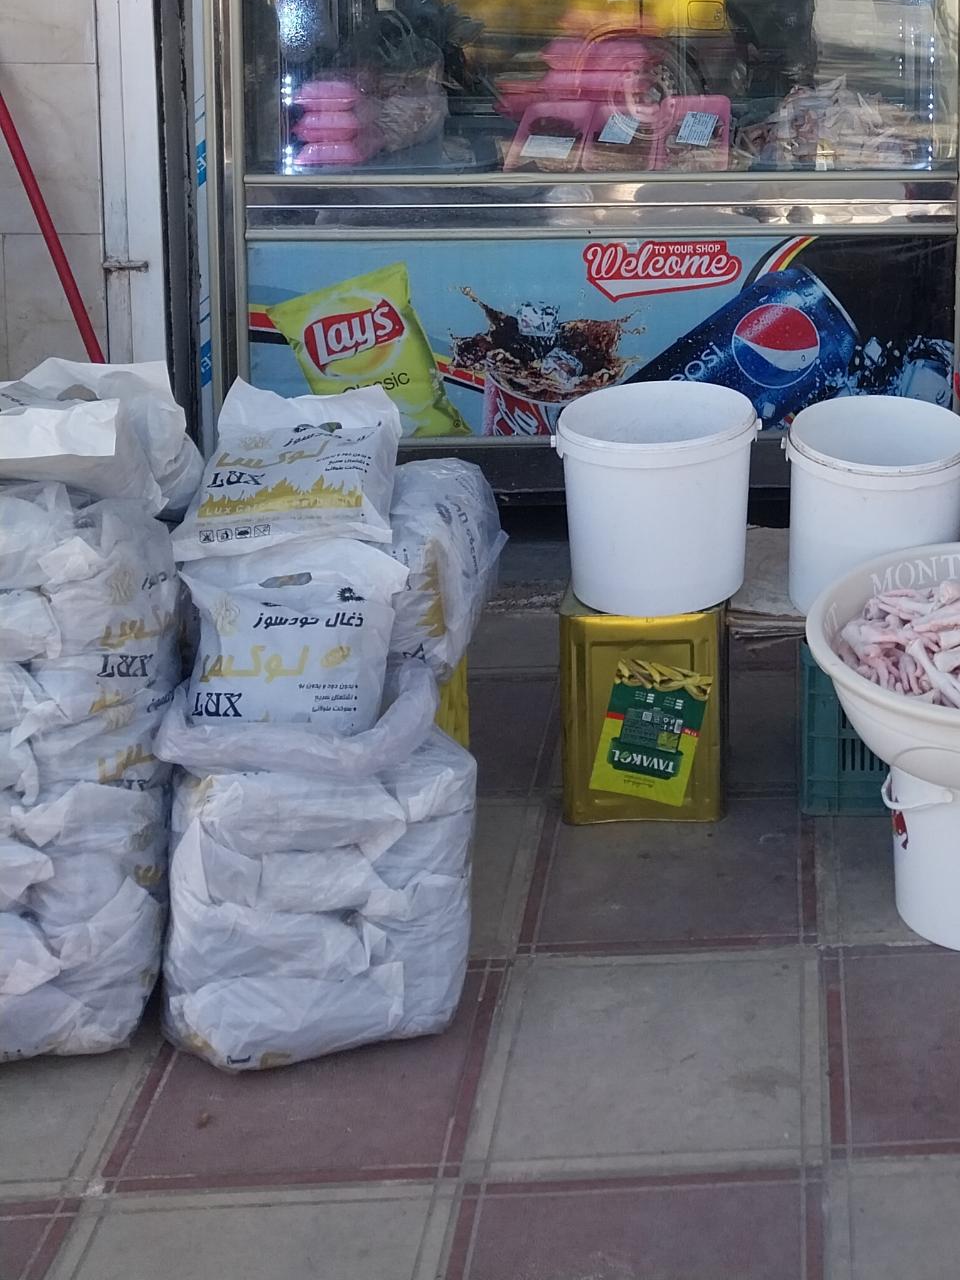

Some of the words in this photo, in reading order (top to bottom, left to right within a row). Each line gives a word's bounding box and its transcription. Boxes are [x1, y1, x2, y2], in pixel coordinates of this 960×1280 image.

[654, 245, 667, 254] TO
[668, 244, 694, 254] YOUR
[695, 244, 721, 253] SHOP
[587, 245, 738, 279] Welcome
[313, 305, 395, 366] Lay's
[207, 470, 266, 489] LUX
[97, 654, 153, 677] LUX
[192, 692, 242, 717] LUX
[612, 749, 675, 773] TAVAKOL
